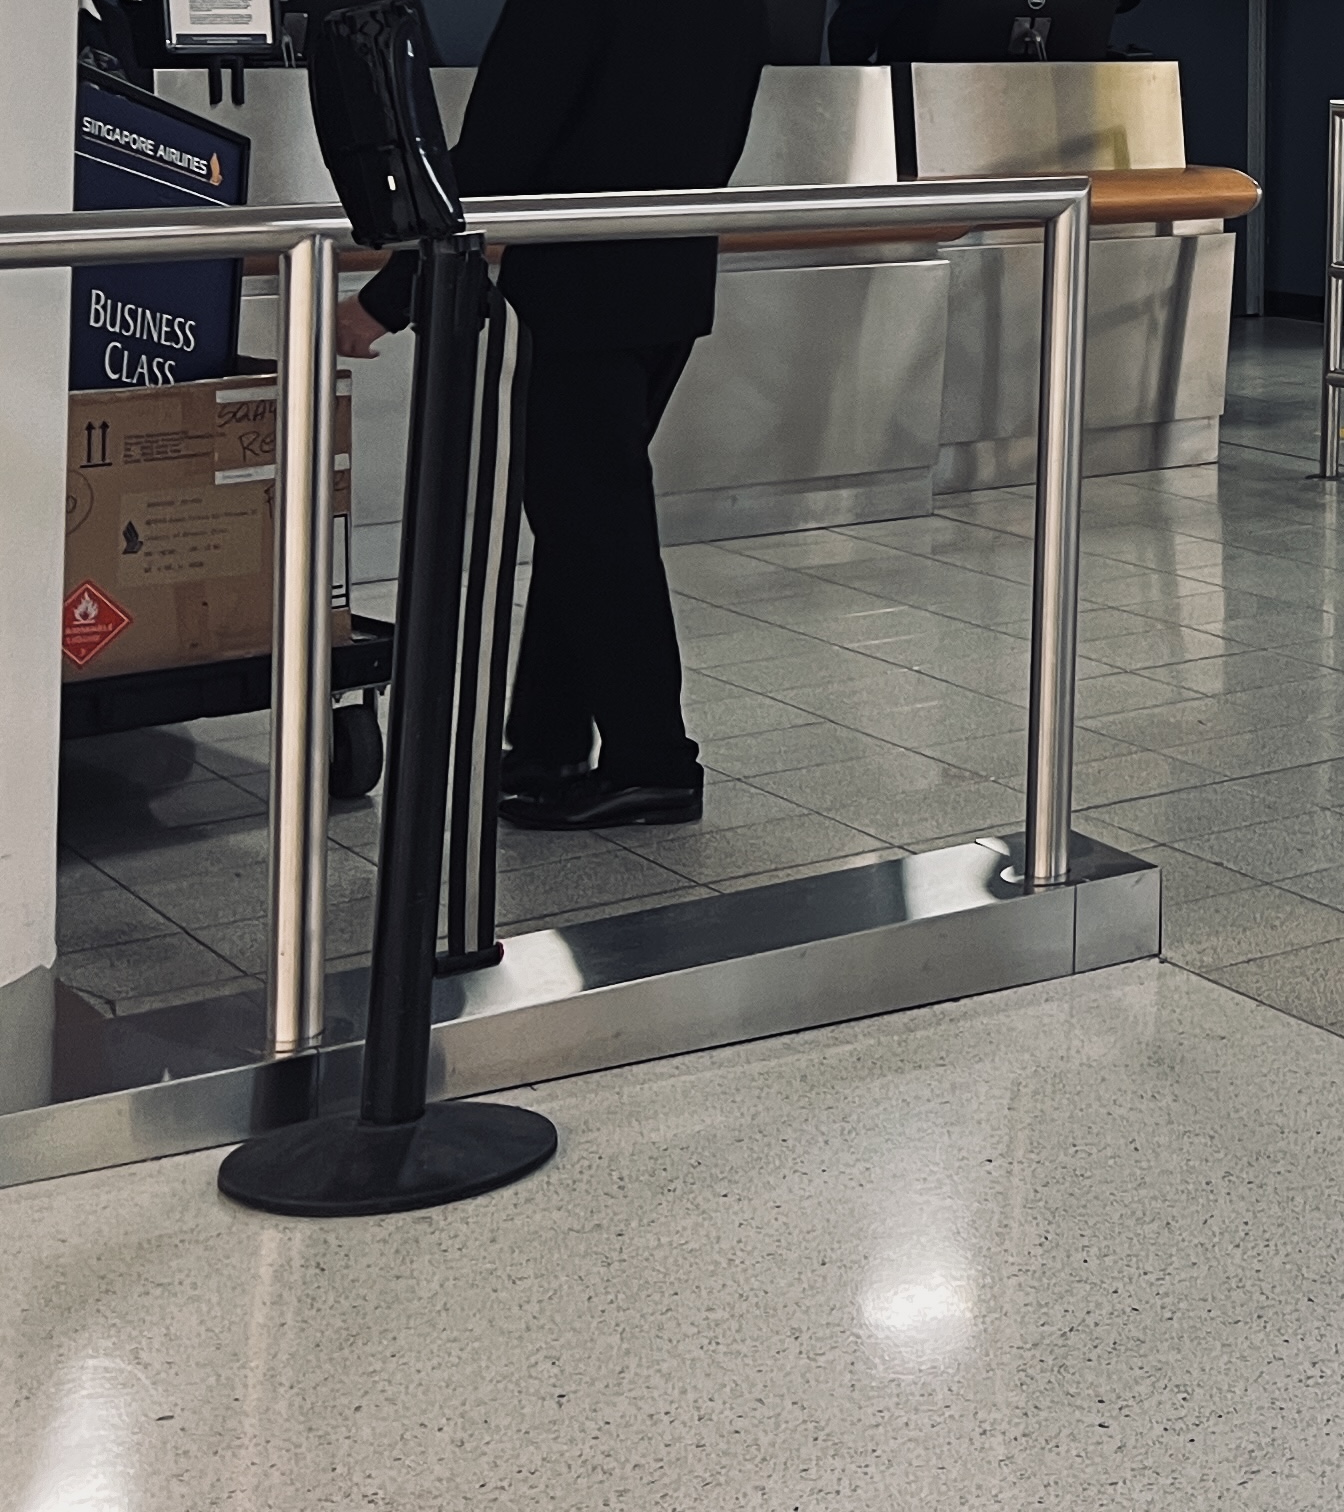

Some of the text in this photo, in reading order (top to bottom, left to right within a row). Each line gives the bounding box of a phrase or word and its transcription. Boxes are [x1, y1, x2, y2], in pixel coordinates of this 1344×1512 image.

[82, 116, 208, 175] SINGAPORE AIRLINES
[89, 288, 196, 352] BUSINESS
[104, 341, 176, 387] CLASS
